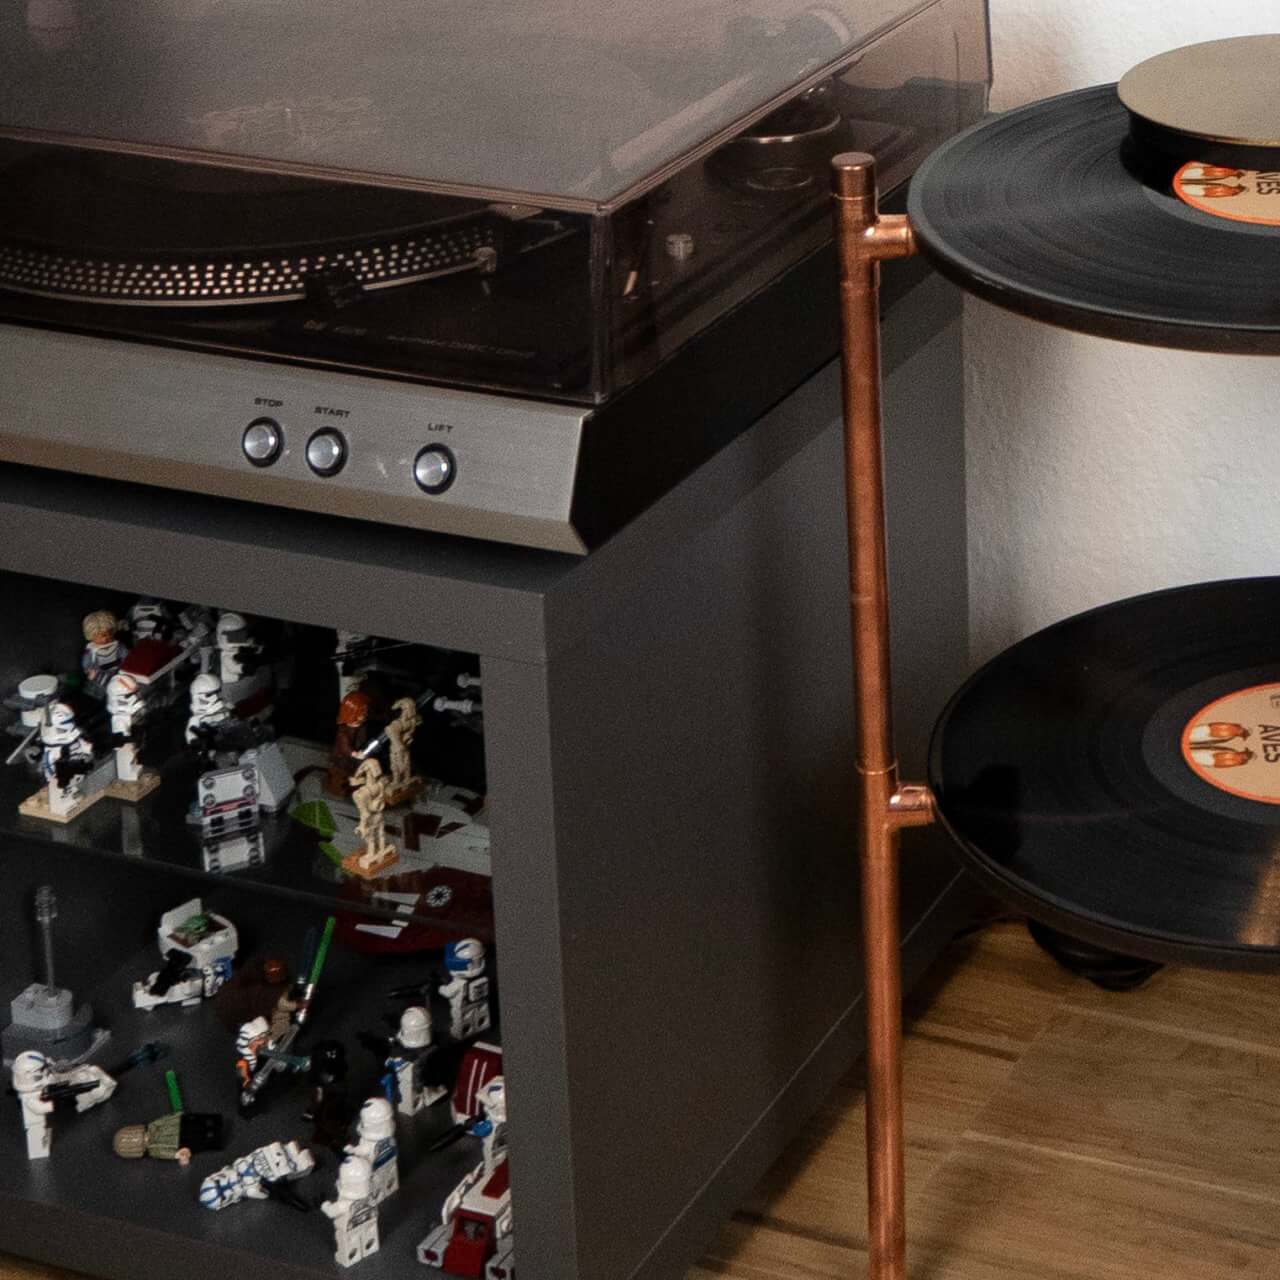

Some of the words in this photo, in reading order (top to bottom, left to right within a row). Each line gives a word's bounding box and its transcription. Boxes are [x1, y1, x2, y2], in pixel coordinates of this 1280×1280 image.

[253, 397, 284, 408] STOP
[313, 406, 351, 418] START
[427, 422, 454, 433] LIFT
